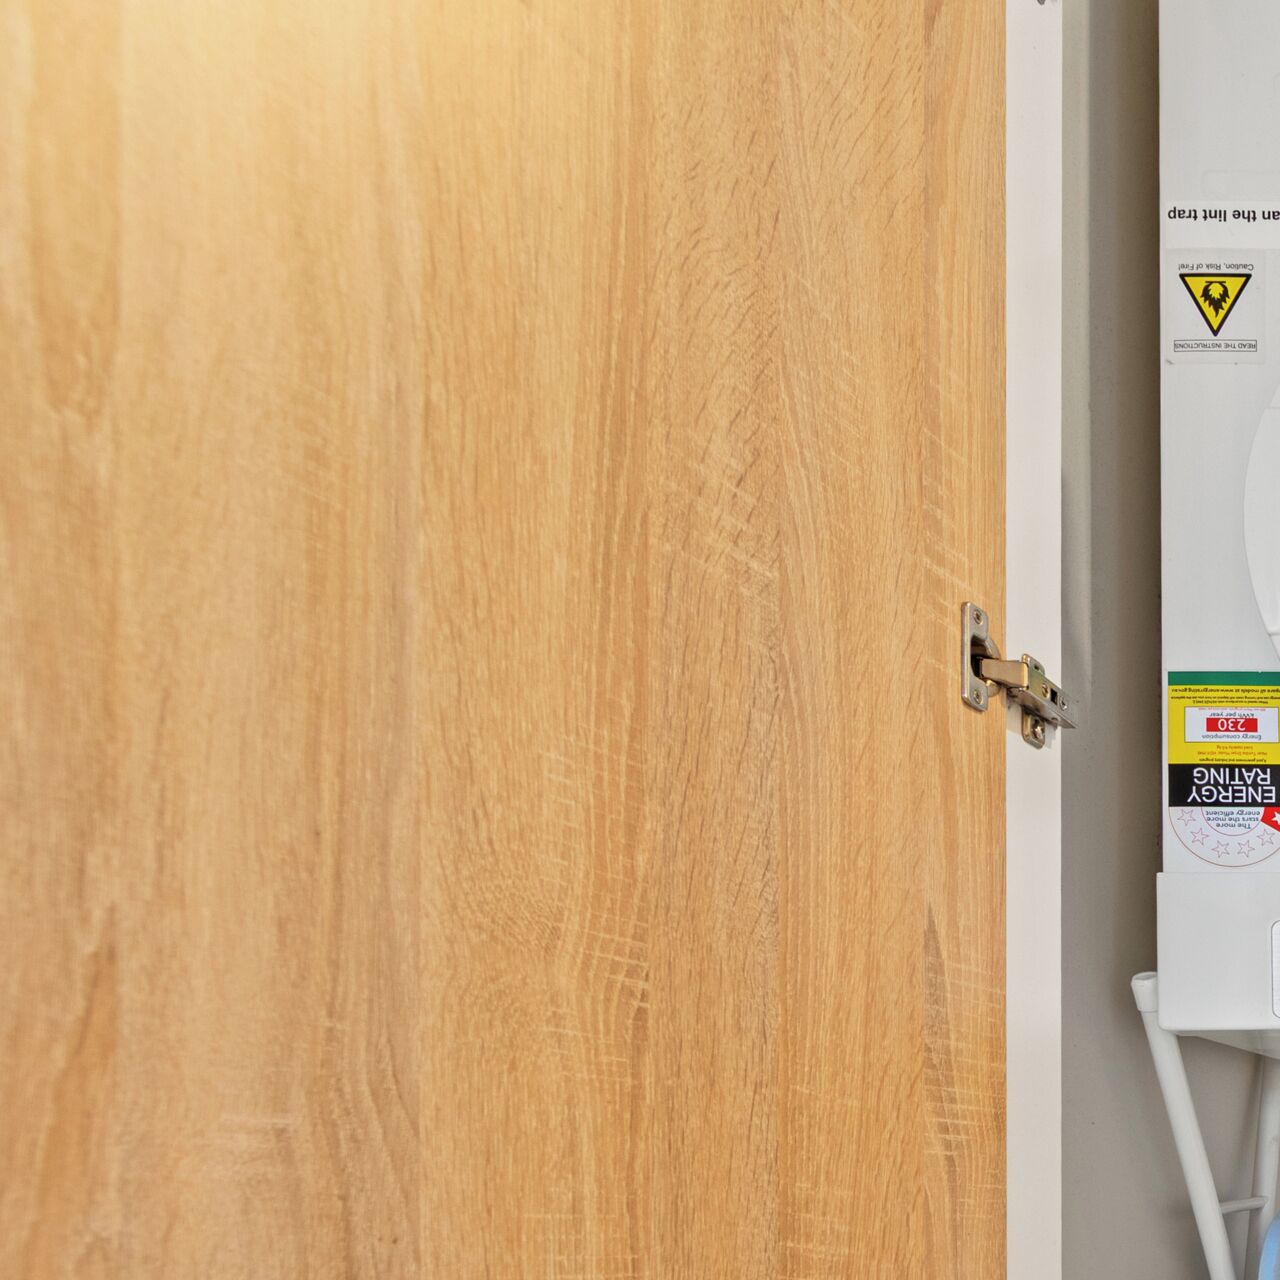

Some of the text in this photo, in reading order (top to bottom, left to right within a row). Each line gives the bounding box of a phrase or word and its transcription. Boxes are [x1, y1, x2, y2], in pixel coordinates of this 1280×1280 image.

[1168, 207, 1197, 220] trap
[1202, 210, 1227, 222] lint
[1232, 210, 1256, 222] the
[1224, 262, 1254, 271] Caution,
[1218, 719, 1245, 730] 230
[1193, 767, 1270, 784] RATING
[1187, 786, 1275, 802] ENERGY
